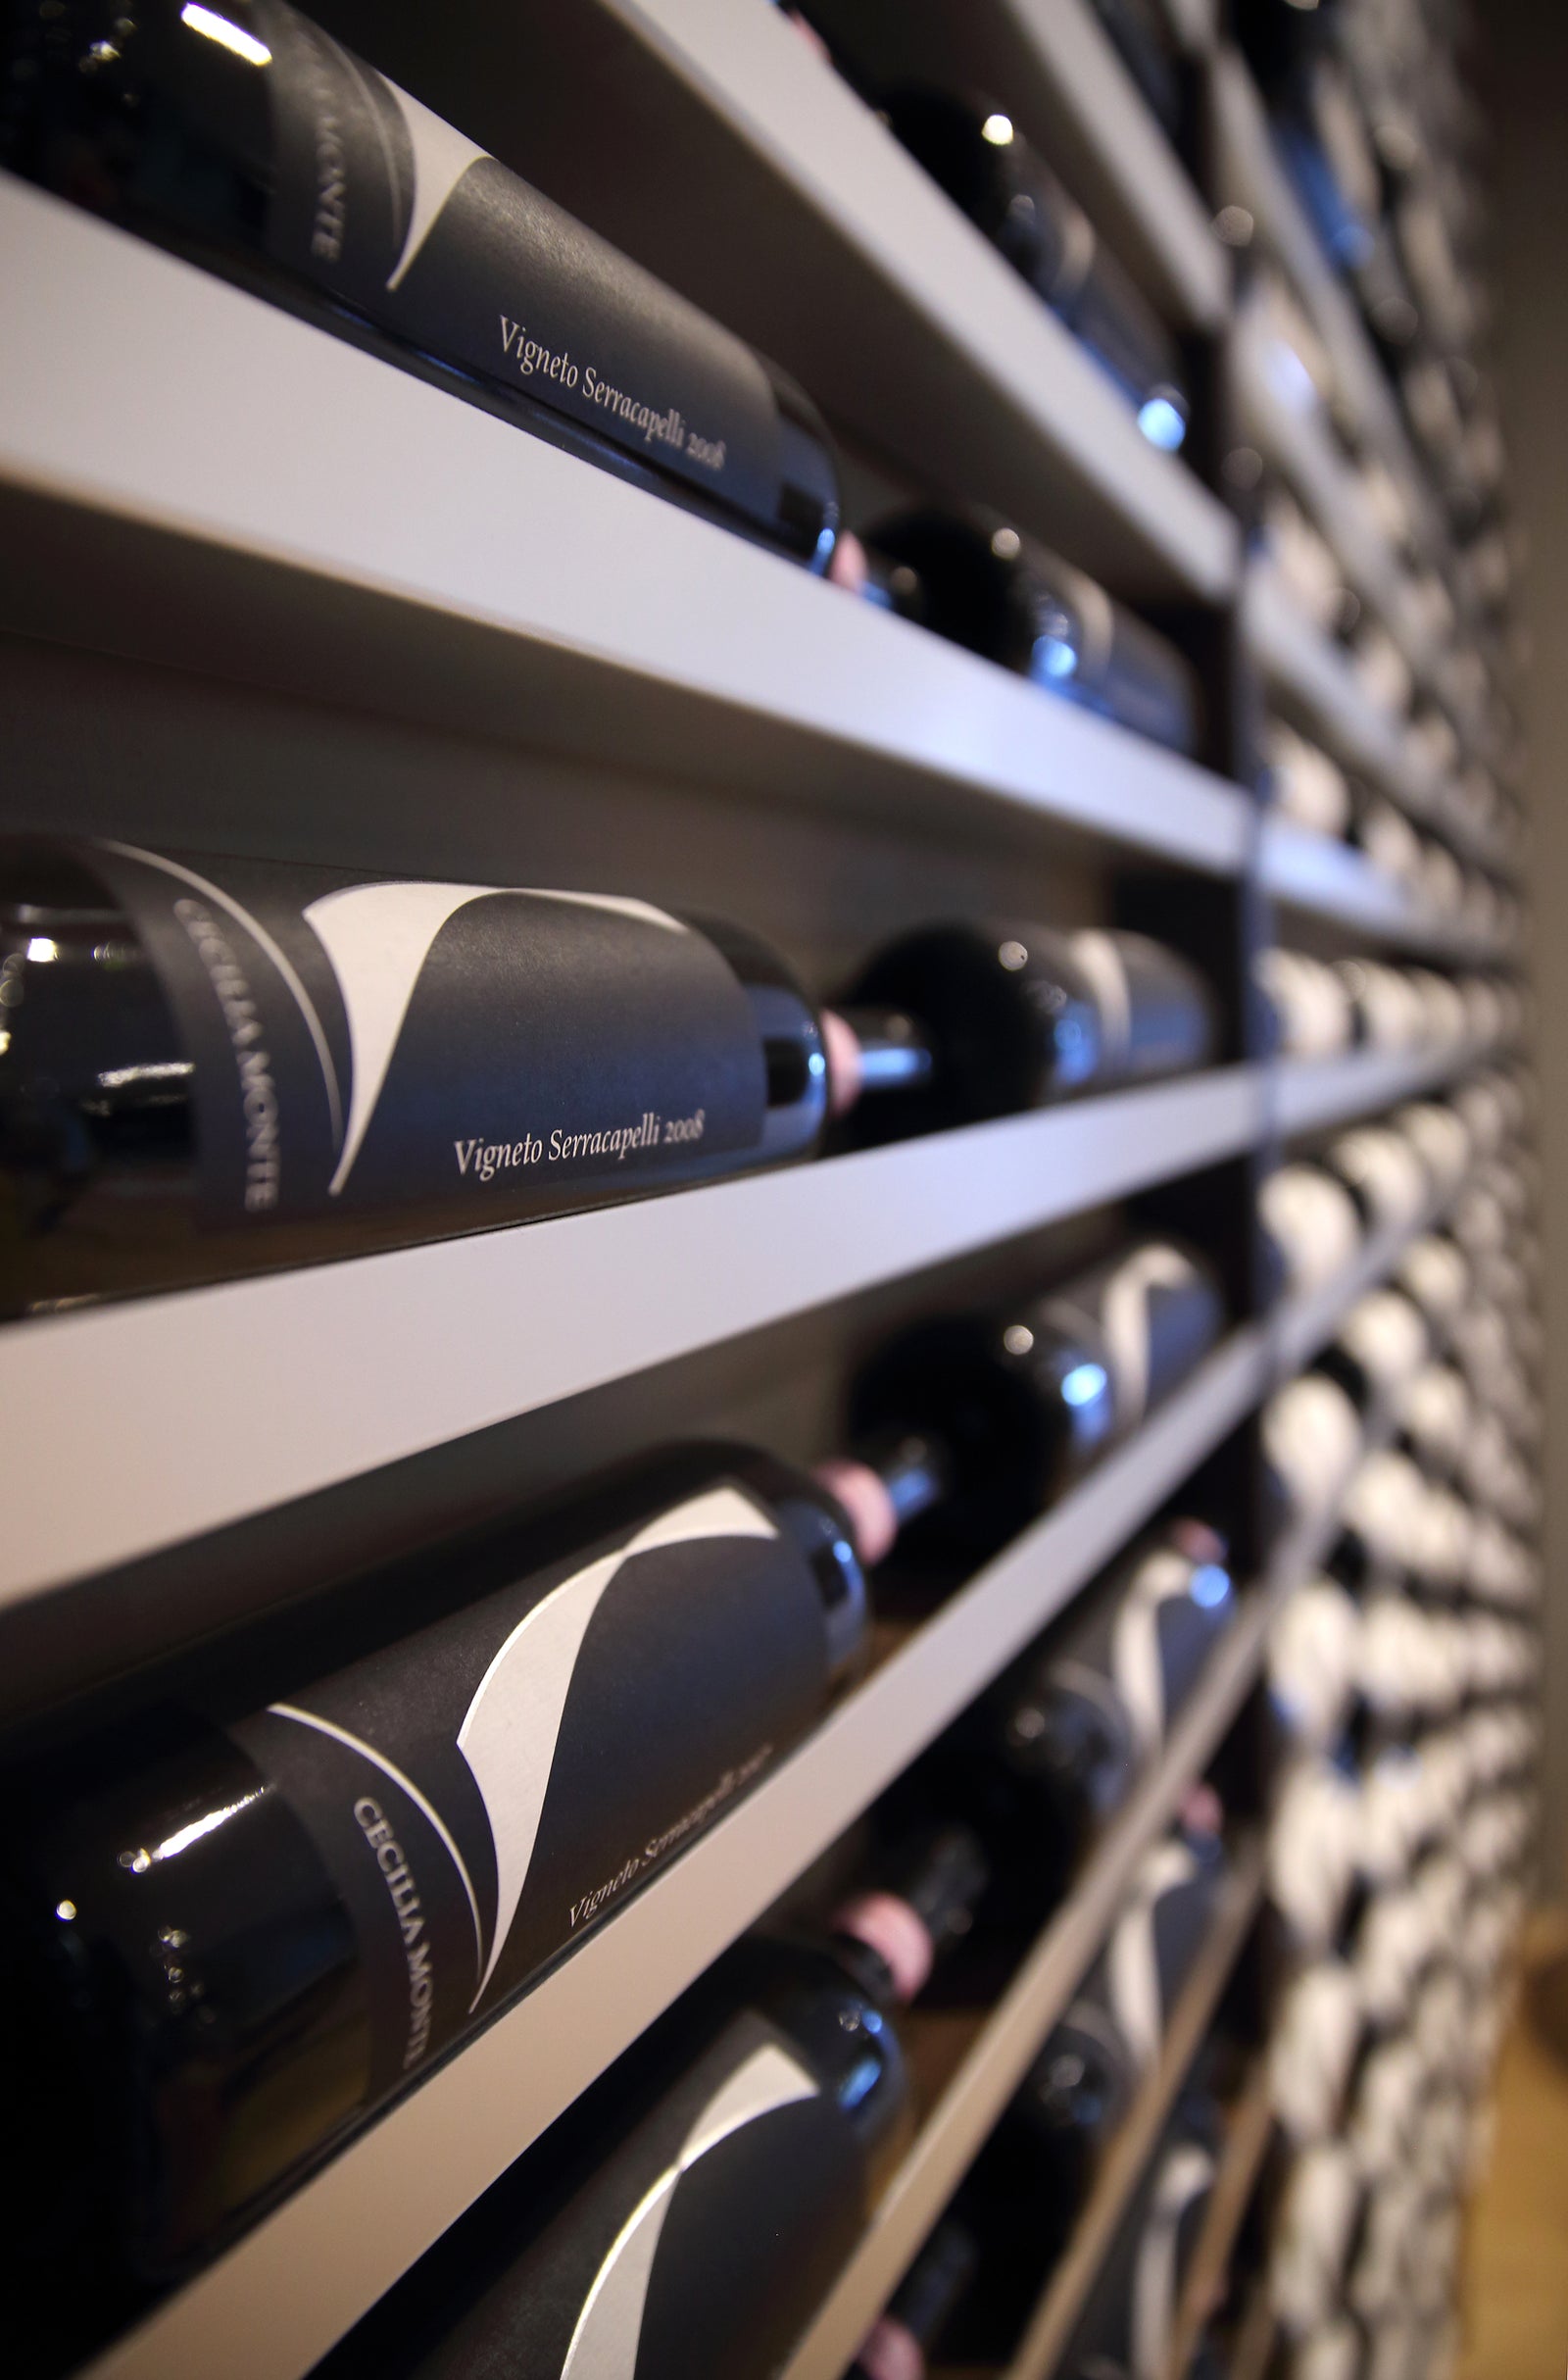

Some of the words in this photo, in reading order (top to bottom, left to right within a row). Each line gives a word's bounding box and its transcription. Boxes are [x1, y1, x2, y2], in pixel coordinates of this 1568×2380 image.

[499, 314, 579, 388] Vigneto
[582, 366, 686, 450] Serracapelli
[686, 431, 726, 471] 2008
[238, 1050, 281, 1213] MONTE
[454, 1132, 543, 1182] Vigneto
[548, 1111, 662, 1161] Serracapelli
[662, 1108, 706, 1145] 2008
[353, 1796, 426, 1948] CECILIA
[569, 1858, 640, 1928] Vigneto
